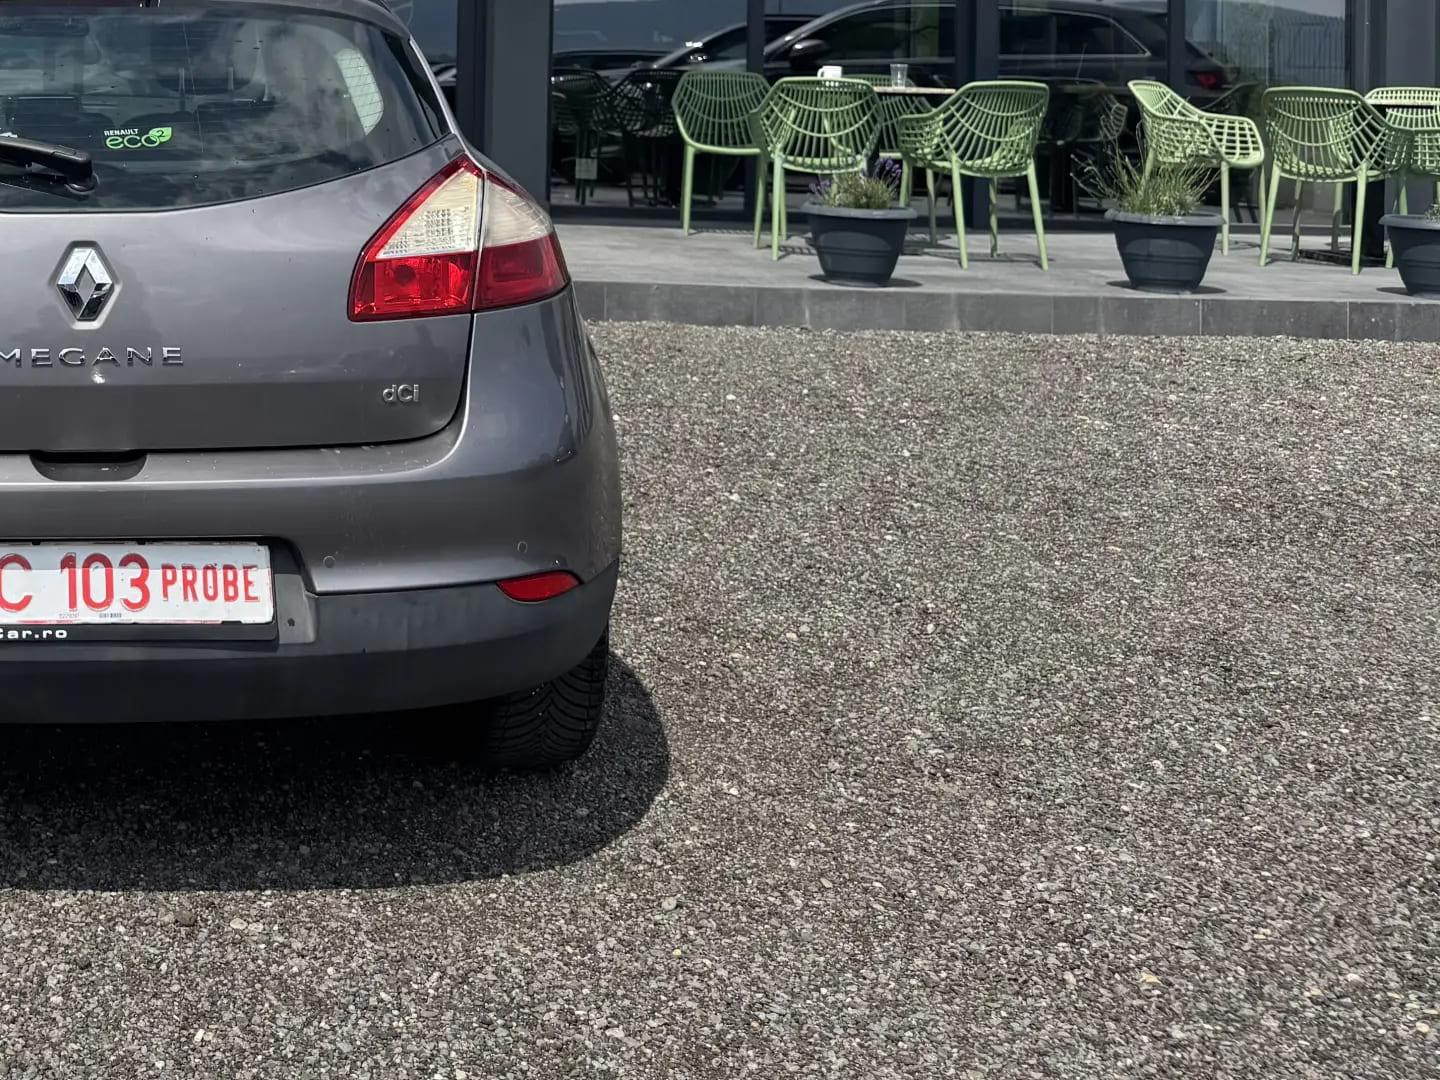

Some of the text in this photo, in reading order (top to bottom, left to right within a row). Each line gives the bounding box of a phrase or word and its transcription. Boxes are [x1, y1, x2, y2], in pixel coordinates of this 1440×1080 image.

[103, 128, 139, 136] RENAULT
[382, 384, 419, 402] dCi
[60, 552, 151, 613] 103
[161, 563, 259, 603] PROBE
